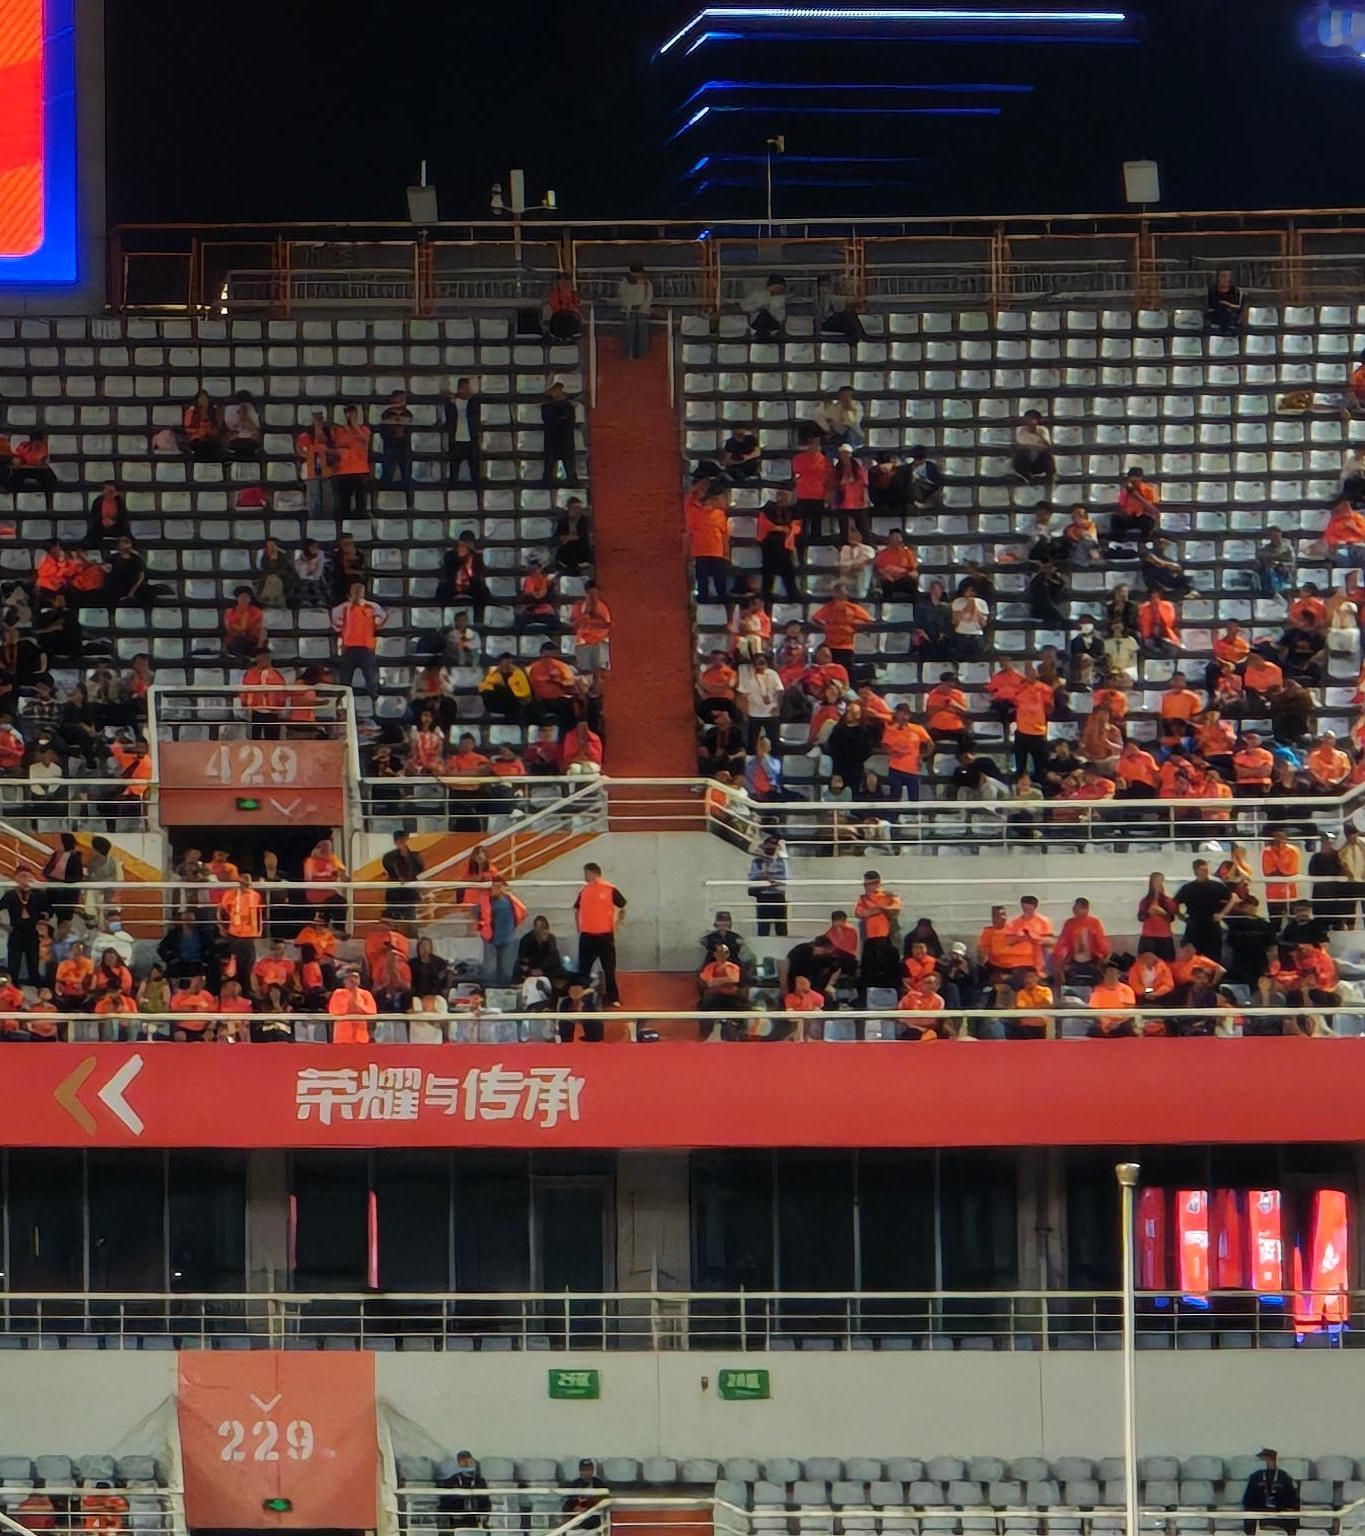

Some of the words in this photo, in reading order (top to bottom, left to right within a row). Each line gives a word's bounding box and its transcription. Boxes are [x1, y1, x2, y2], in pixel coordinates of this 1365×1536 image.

[204, 744, 299, 785] 429
[295, 1063, 586, 1128] 荣耀与传承
[217, 1419, 314, 1462] 229
